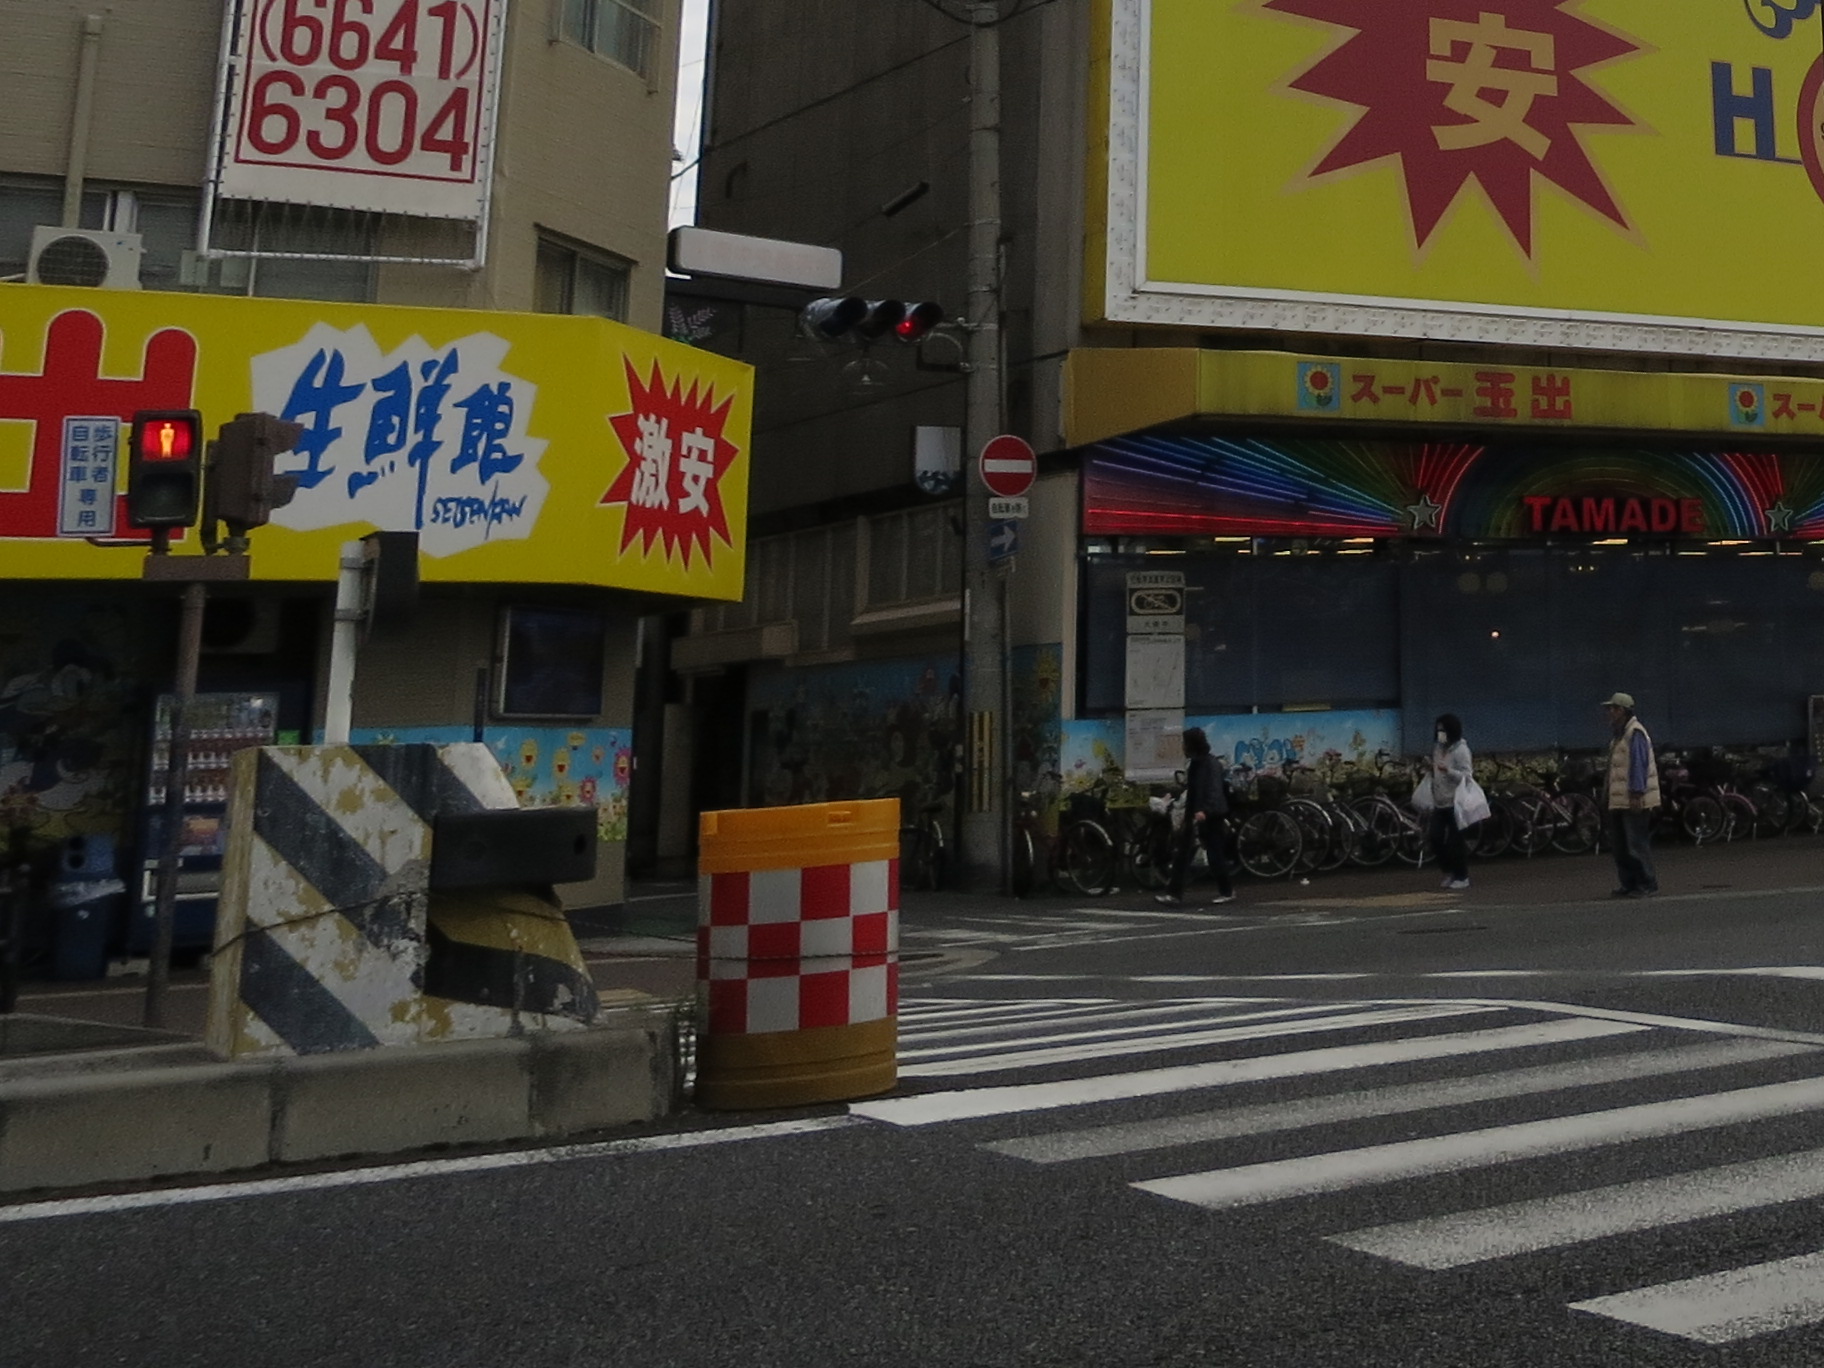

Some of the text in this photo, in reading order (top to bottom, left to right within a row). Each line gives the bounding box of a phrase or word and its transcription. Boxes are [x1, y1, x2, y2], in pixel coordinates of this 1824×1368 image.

[247, 69, 470, 171] 6304
[69, 426, 89, 482] 自転車
[92, 426, 113, 483] 歩行者
[275, 348, 524, 529] 生鮮館
[630, 413, 716, 519] 激安
[79, 489, 97, 527] 専用
[1523, 495, 1705, 533] TAMADE
